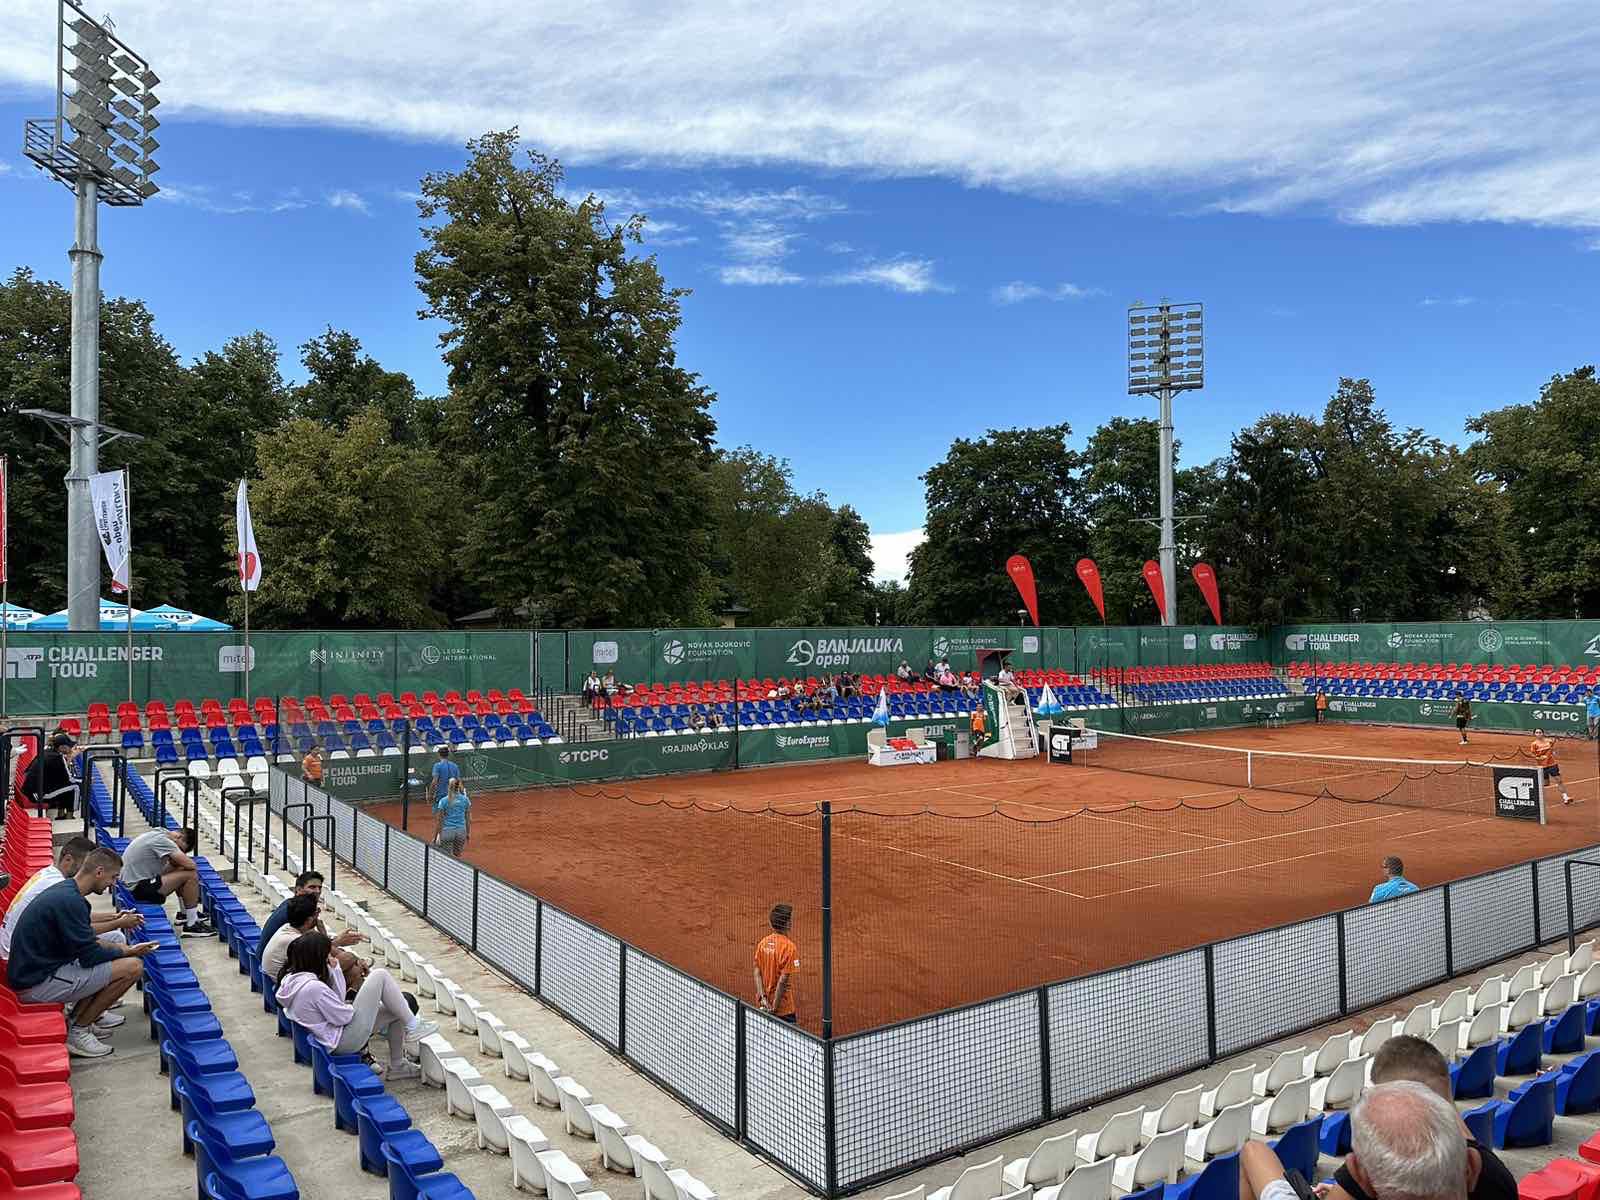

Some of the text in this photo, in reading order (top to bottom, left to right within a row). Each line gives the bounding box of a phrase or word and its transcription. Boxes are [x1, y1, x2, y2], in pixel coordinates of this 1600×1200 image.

[1309, 634, 1360, 642] CHALLENGER
[817, 638, 904, 654] BANJALUKA
[1310, 642, 1330, 650] TOUR
[48, 646, 163, 661] CHALLENGER
[330, 650, 385, 659] INFINITY
[815, 654, 849, 668] open
[48, 662, 97, 678] TOUR
[1543, 710, 1579, 722] TCPC
[662, 740, 729, 755] KRAJINA KLAS
[787, 735, 830, 749] EuroExpress
[570, 749, 609, 762] TCPC
[330, 763, 392, 778] CHALLENGER
[331, 775, 357, 786] TOUR
[1498, 798, 1535, 807] CHALLENGER
